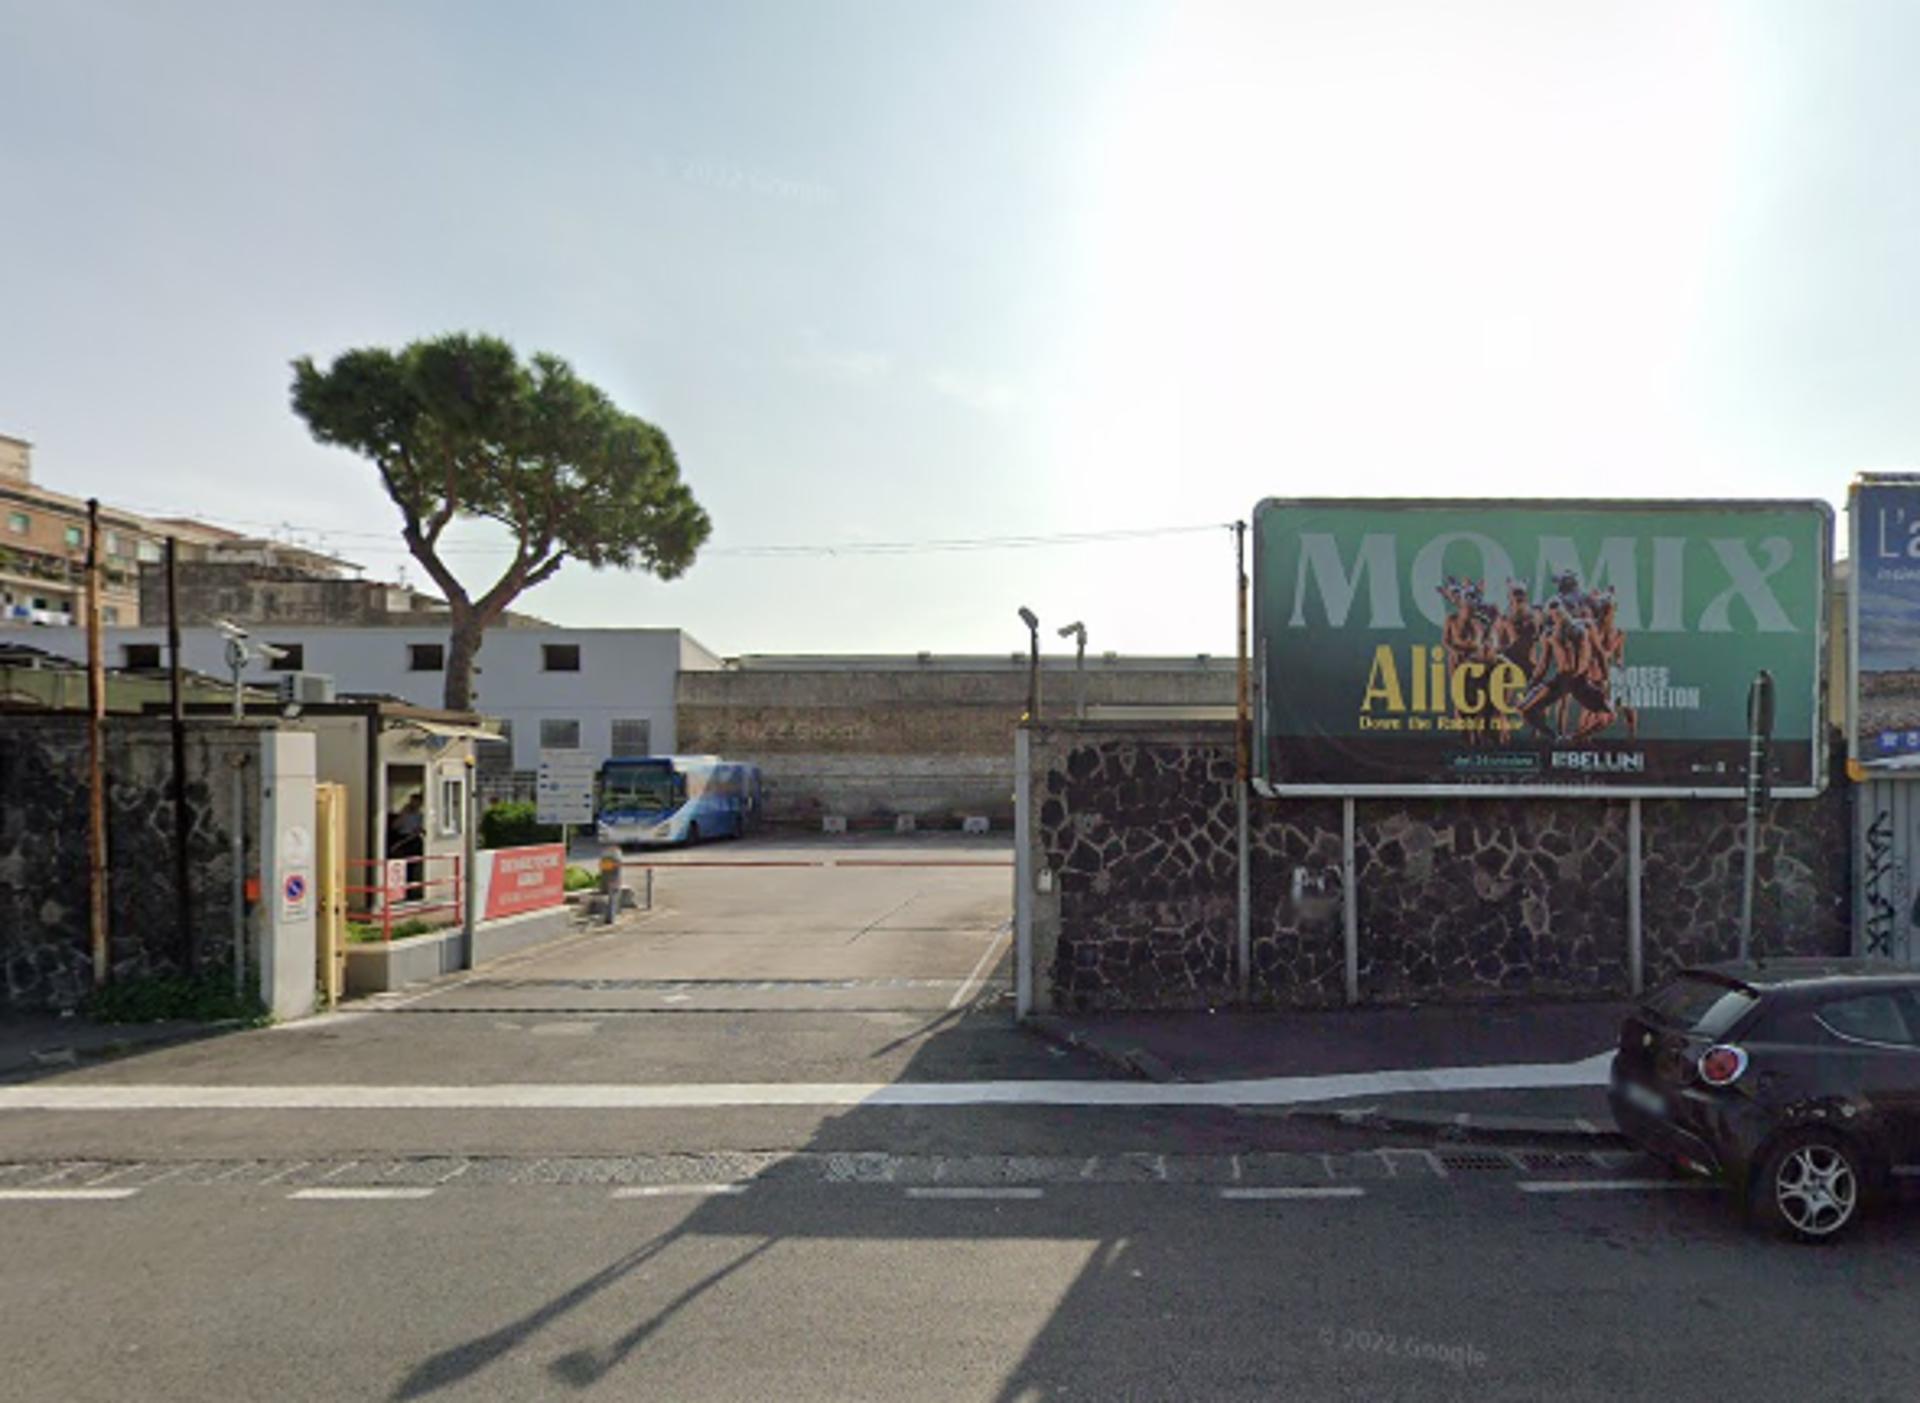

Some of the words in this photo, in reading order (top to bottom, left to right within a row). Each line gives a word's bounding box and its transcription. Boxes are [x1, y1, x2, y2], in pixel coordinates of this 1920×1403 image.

[1288, 531, 1801, 633] MOMIX
[1360, 644, 1528, 714] Alice
[1408, 716, 1432, 730] the
